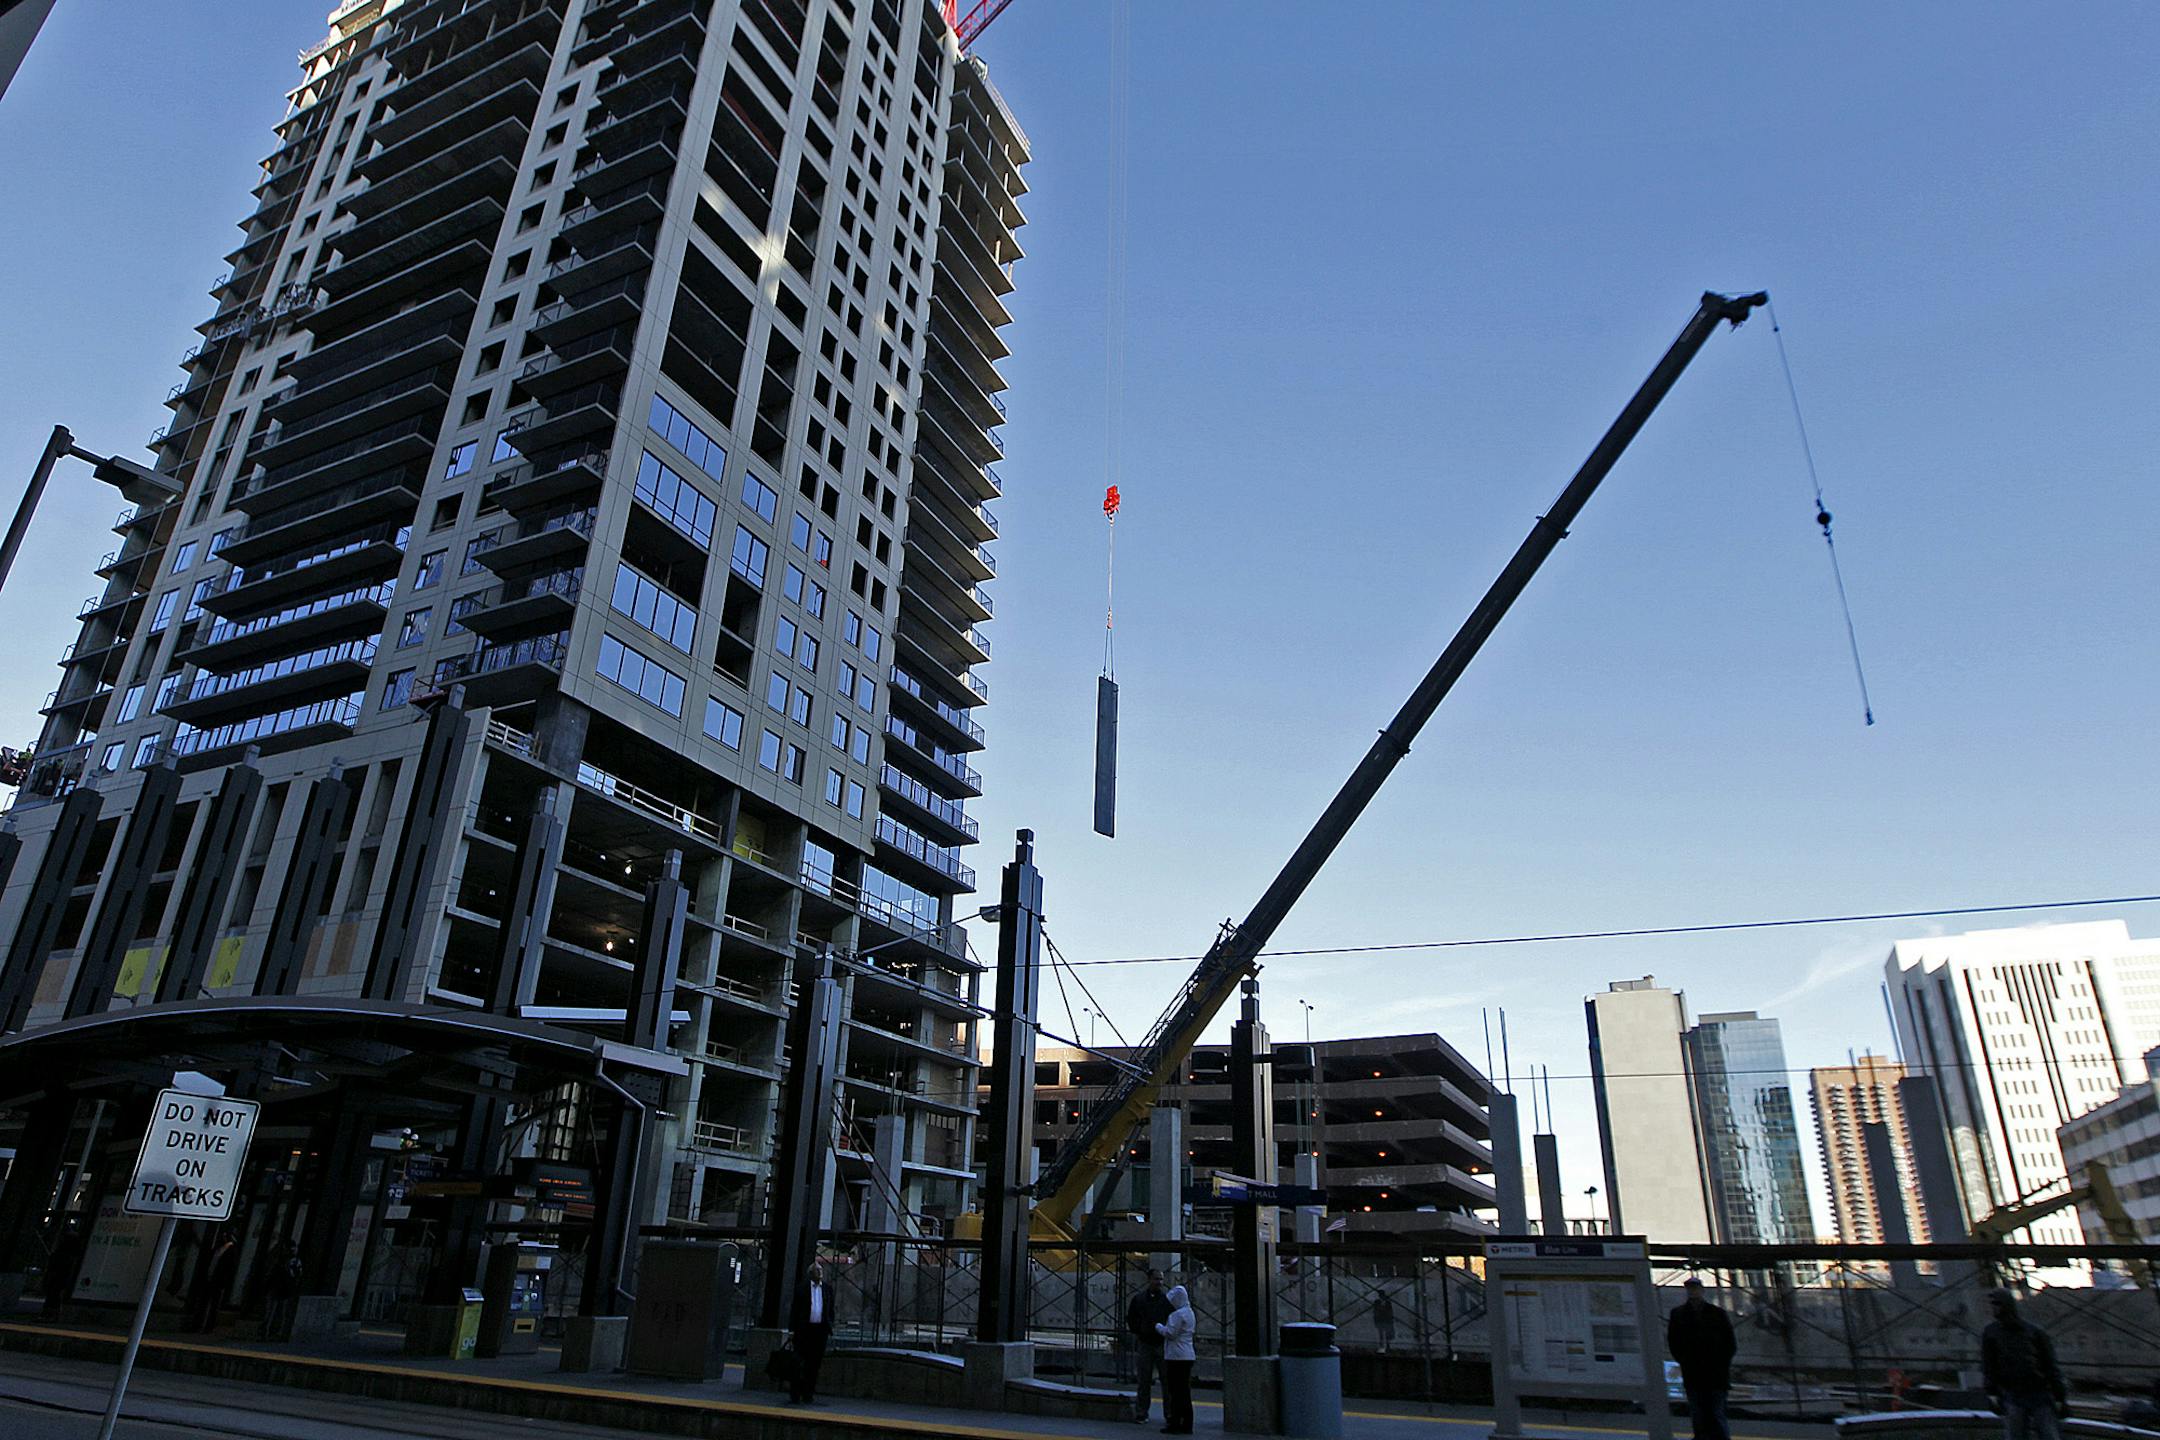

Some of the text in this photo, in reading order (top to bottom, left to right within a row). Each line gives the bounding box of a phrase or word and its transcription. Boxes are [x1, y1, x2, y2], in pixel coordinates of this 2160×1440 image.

[164, 1103, 246, 1129] DO NOT
[166, 1130, 229, 1154] DRIVE
[176, 1159, 206, 1178] ON
[141, 1183, 224, 1207] TRACKS
